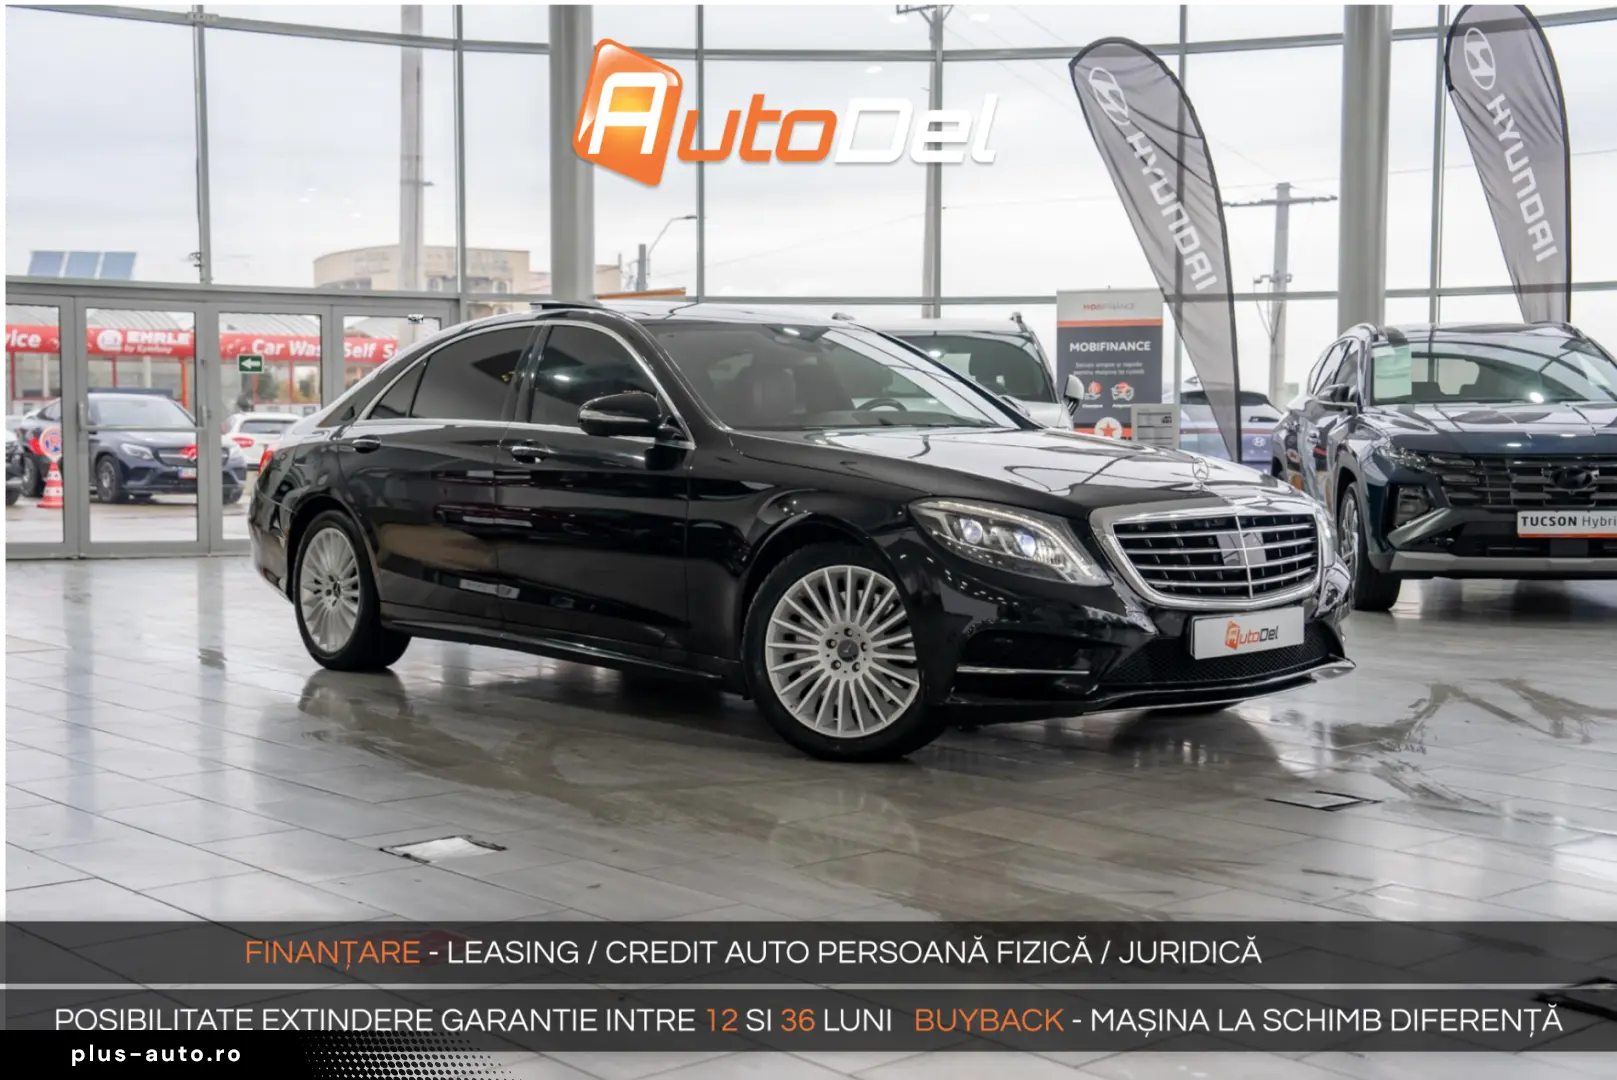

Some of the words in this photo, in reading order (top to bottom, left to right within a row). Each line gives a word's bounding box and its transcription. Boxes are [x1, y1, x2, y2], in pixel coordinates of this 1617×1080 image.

[1487, 93, 1558, 262] HYUNDAI
[1127, 131, 1217, 292] HYUNDAI
[252, 339, 285, 356] Car
[1069, 341, 1152, 352] MOBIFINANCE
[1521, 516, 1577, 527] TUCSON
[1226, 624, 1279, 647] AutoDel
